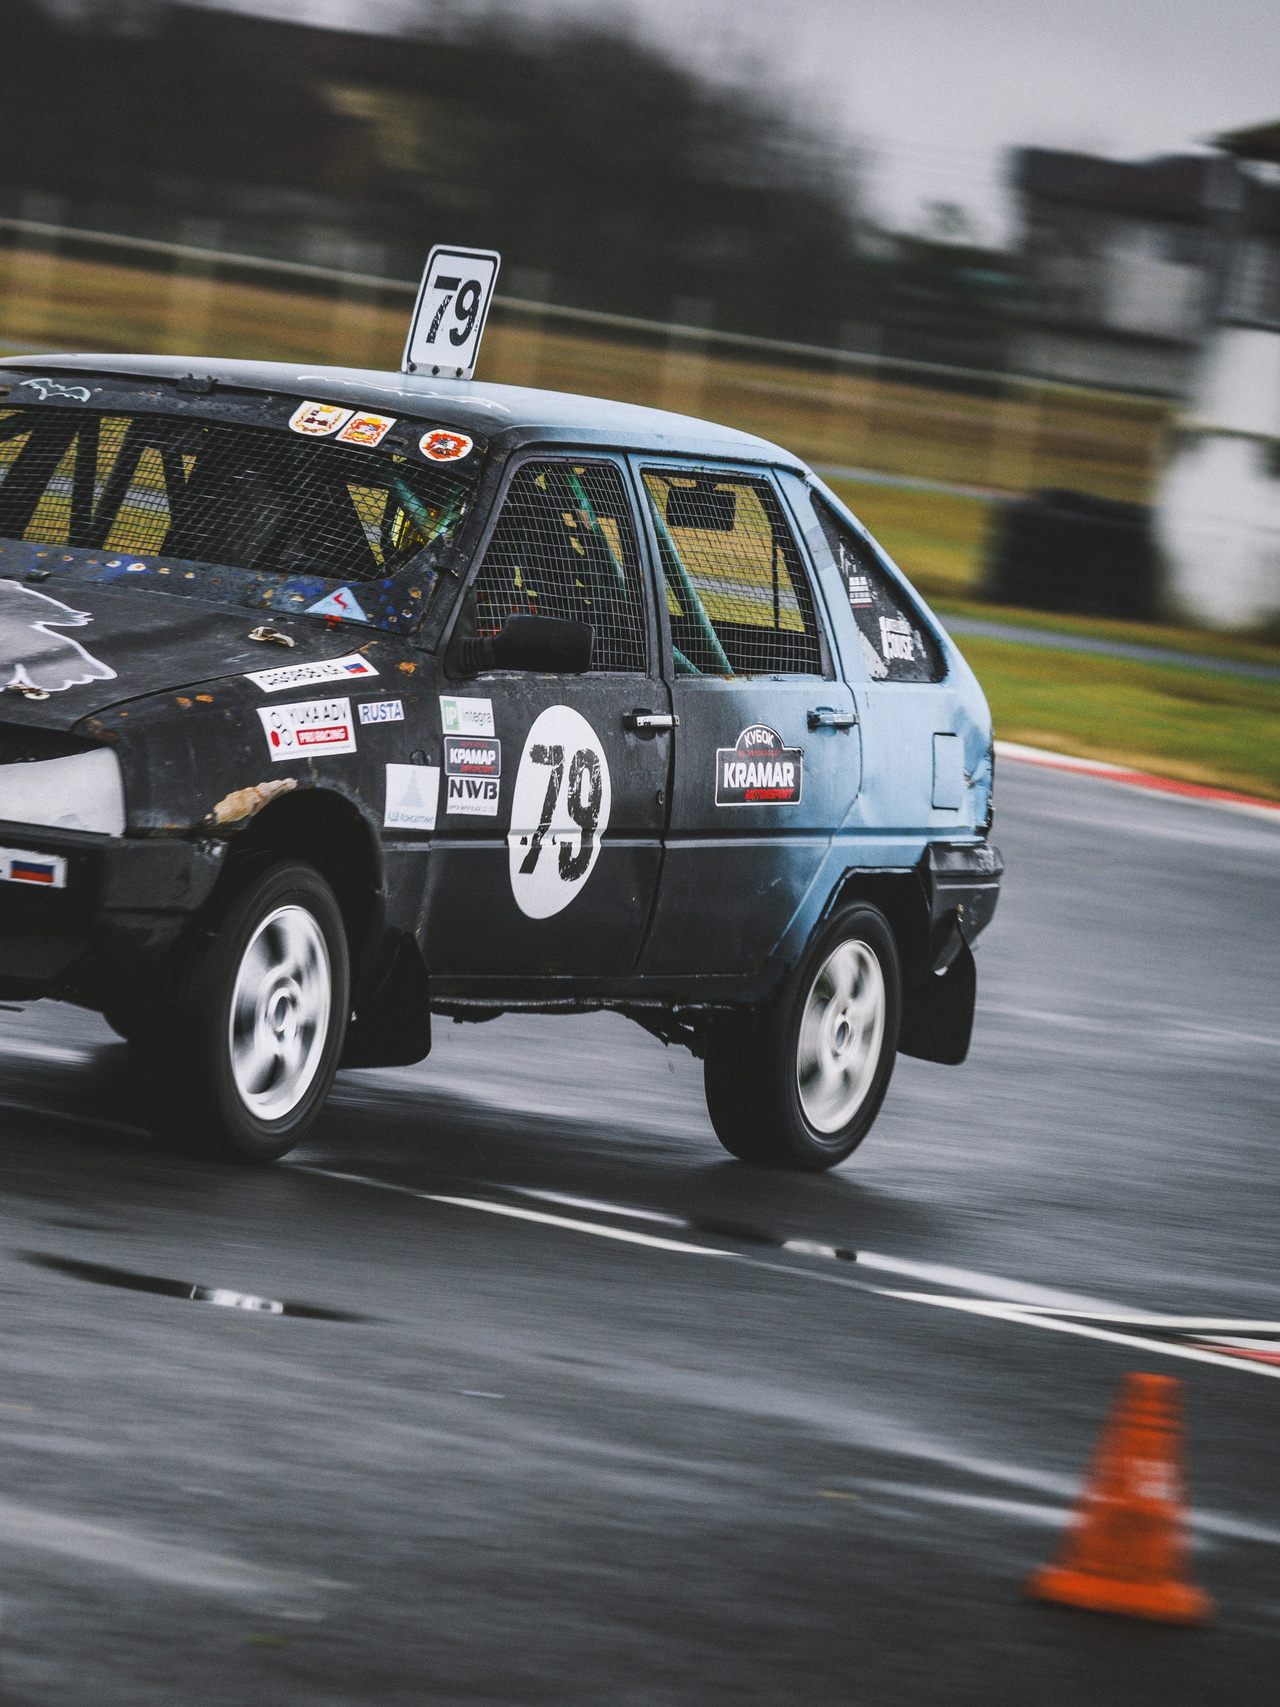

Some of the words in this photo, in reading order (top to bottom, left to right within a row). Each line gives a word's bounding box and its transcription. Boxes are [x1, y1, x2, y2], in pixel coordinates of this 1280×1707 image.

[426, 275, 482, 347] 79
[362, 703, 403, 722] RUSTA
[462, 706, 492, 726] integra
[744, 729, 775, 748] КУБОК
[449, 748, 496, 766] КРАМАР
[724, 762, 795, 788] KRAMAR
[449, 780, 498, 800] NWB
[745, 788, 795, 801] MOTORSPORT
[519, 744, 602, 882] 79
